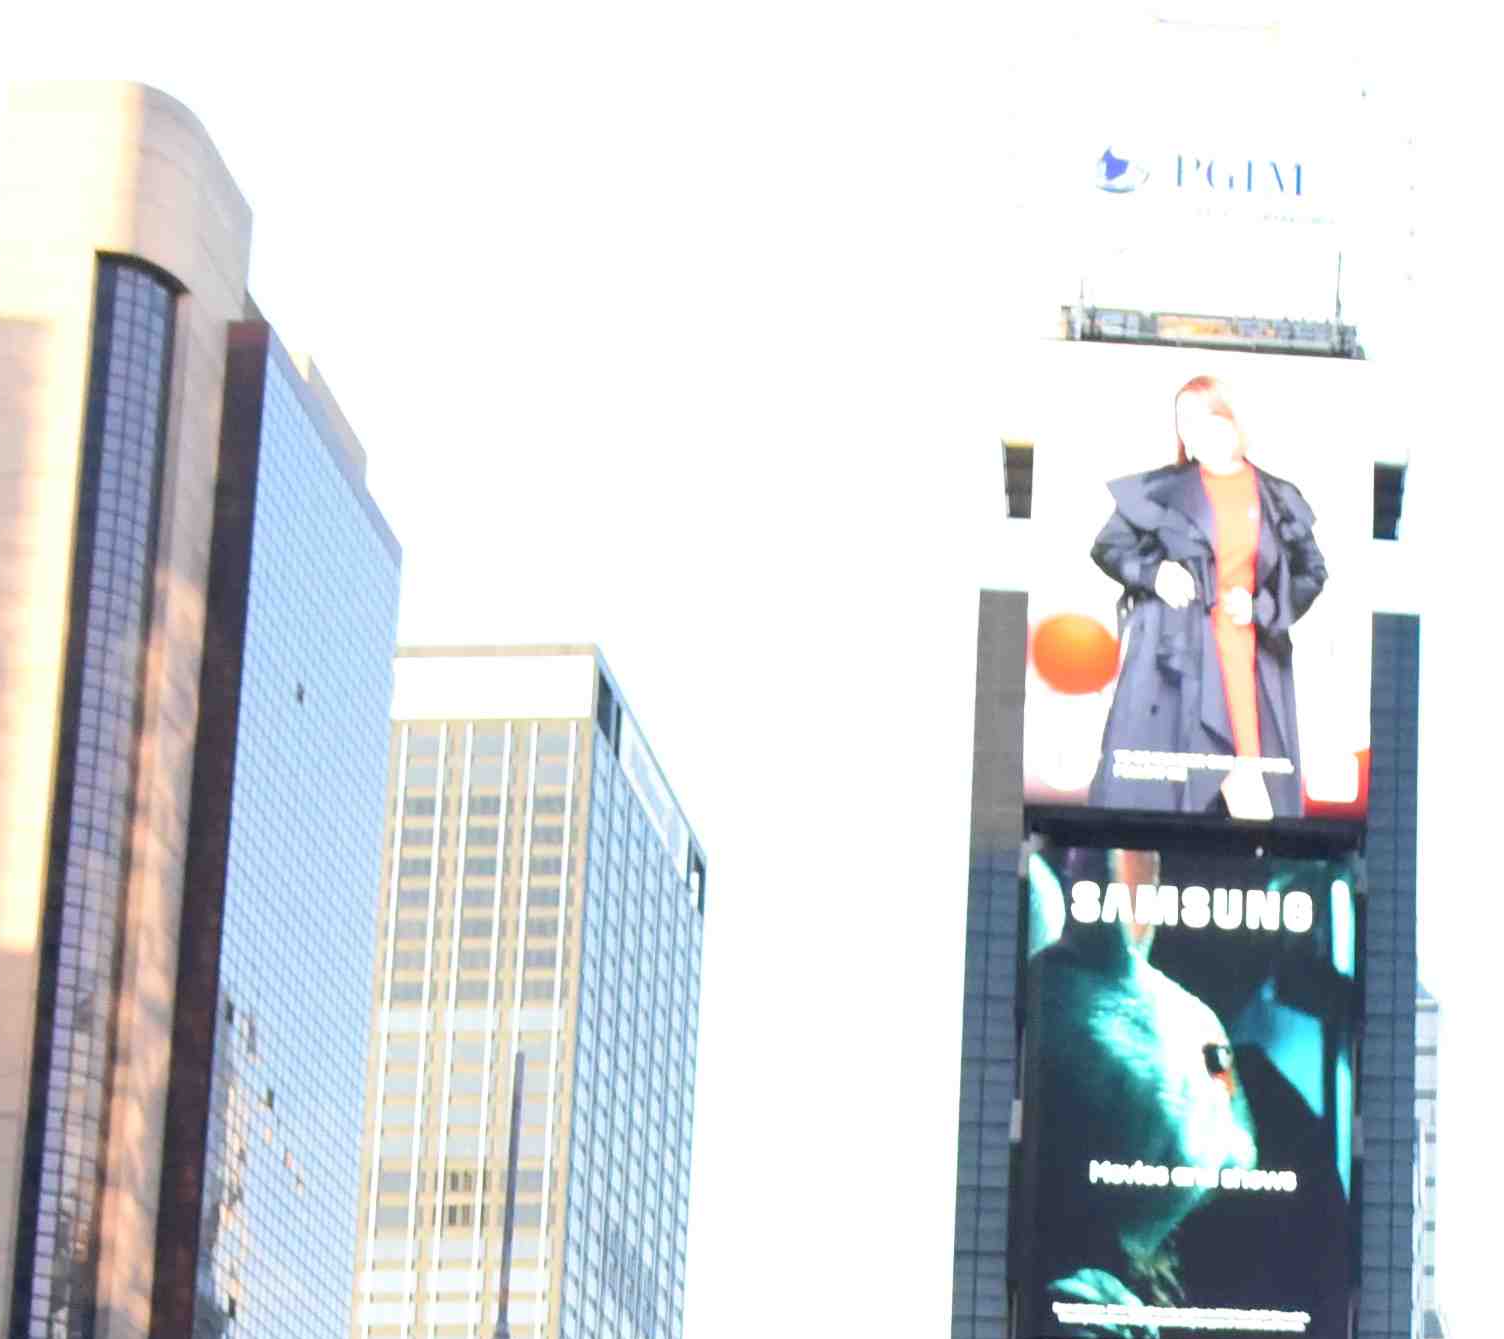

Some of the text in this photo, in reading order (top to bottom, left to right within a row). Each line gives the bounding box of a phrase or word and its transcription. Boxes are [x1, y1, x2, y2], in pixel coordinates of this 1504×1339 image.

[1176, 153, 1304, 196] PGIM
[1070, 880, 1314, 933] SAMSUNG
[1089, 1162, 1168, 1186] Movies
[1221, 1167, 1297, 1190] shows
